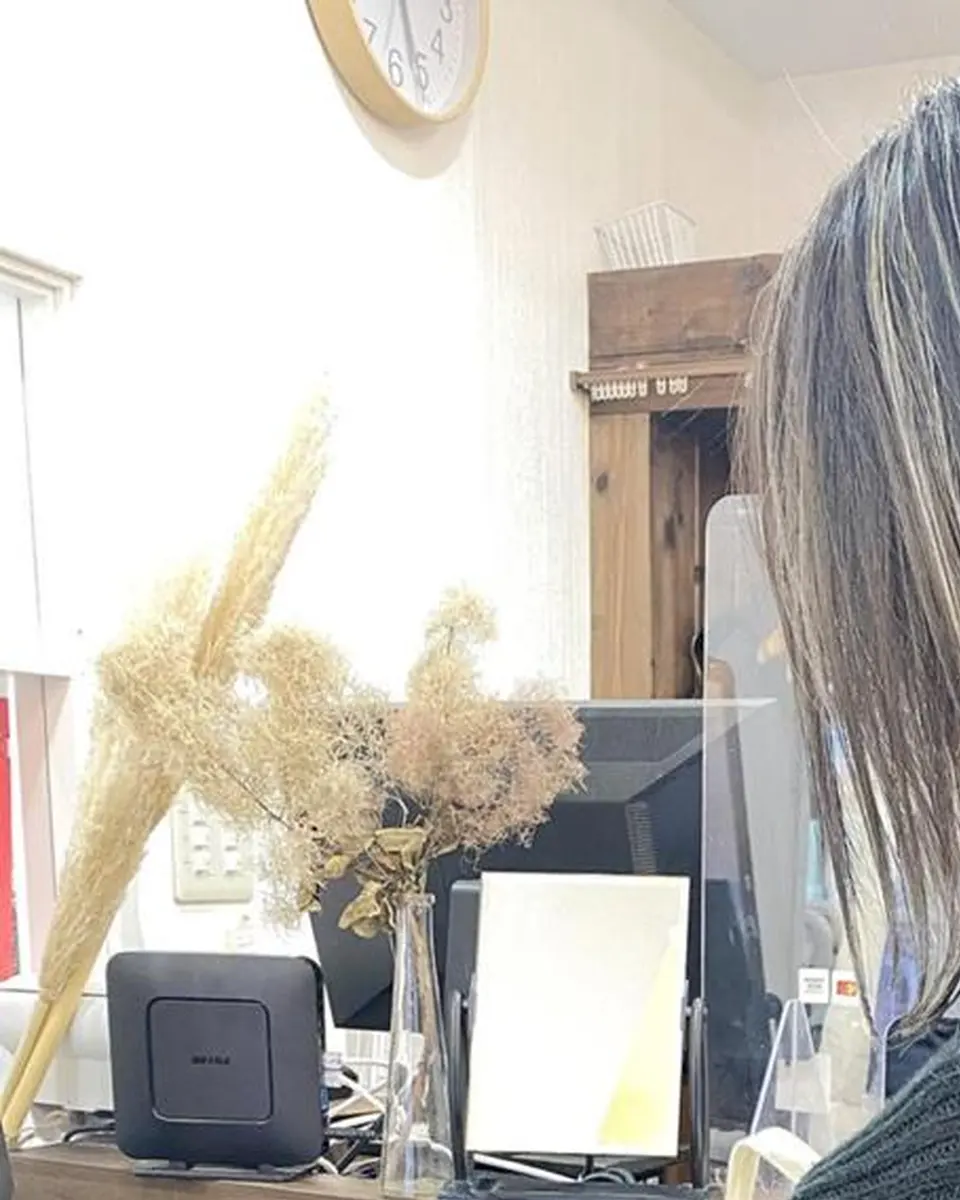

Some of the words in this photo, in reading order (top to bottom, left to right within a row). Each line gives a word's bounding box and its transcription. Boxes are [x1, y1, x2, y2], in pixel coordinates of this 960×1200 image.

[362, 17, 378, 45] 7
[430, 27, 445, 65] 4
[388, 48, 404, 87] 6
